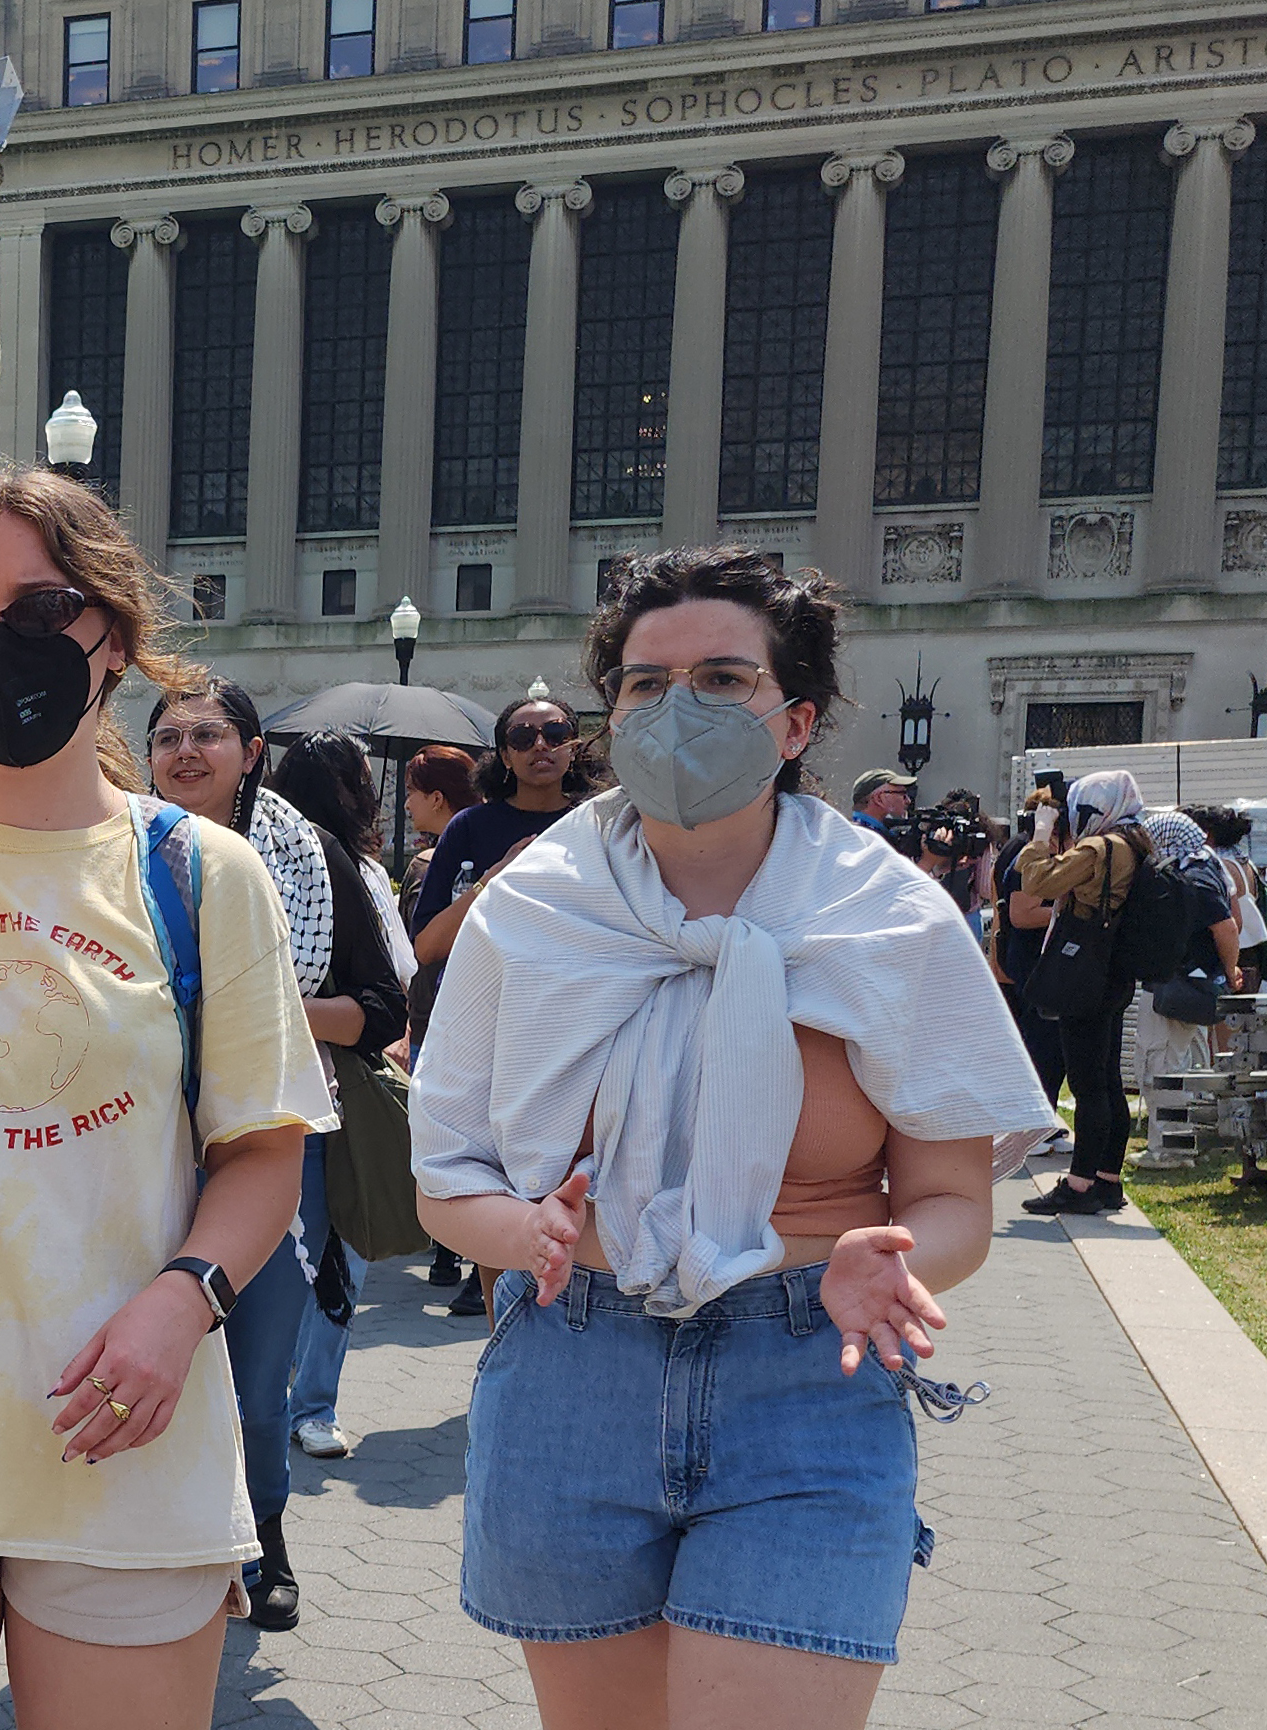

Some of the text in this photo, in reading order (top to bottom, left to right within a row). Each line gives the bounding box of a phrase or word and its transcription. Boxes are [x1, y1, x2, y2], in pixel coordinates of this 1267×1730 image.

[171, 36, 1267, 171] HOMER HERODOTUS SOPHOCLES PLATO ARIST
[50, 924, 136, 982] EARTH
[3, 1123, 64, 1150] THE
[72, 1090, 136, 1138] RICH
